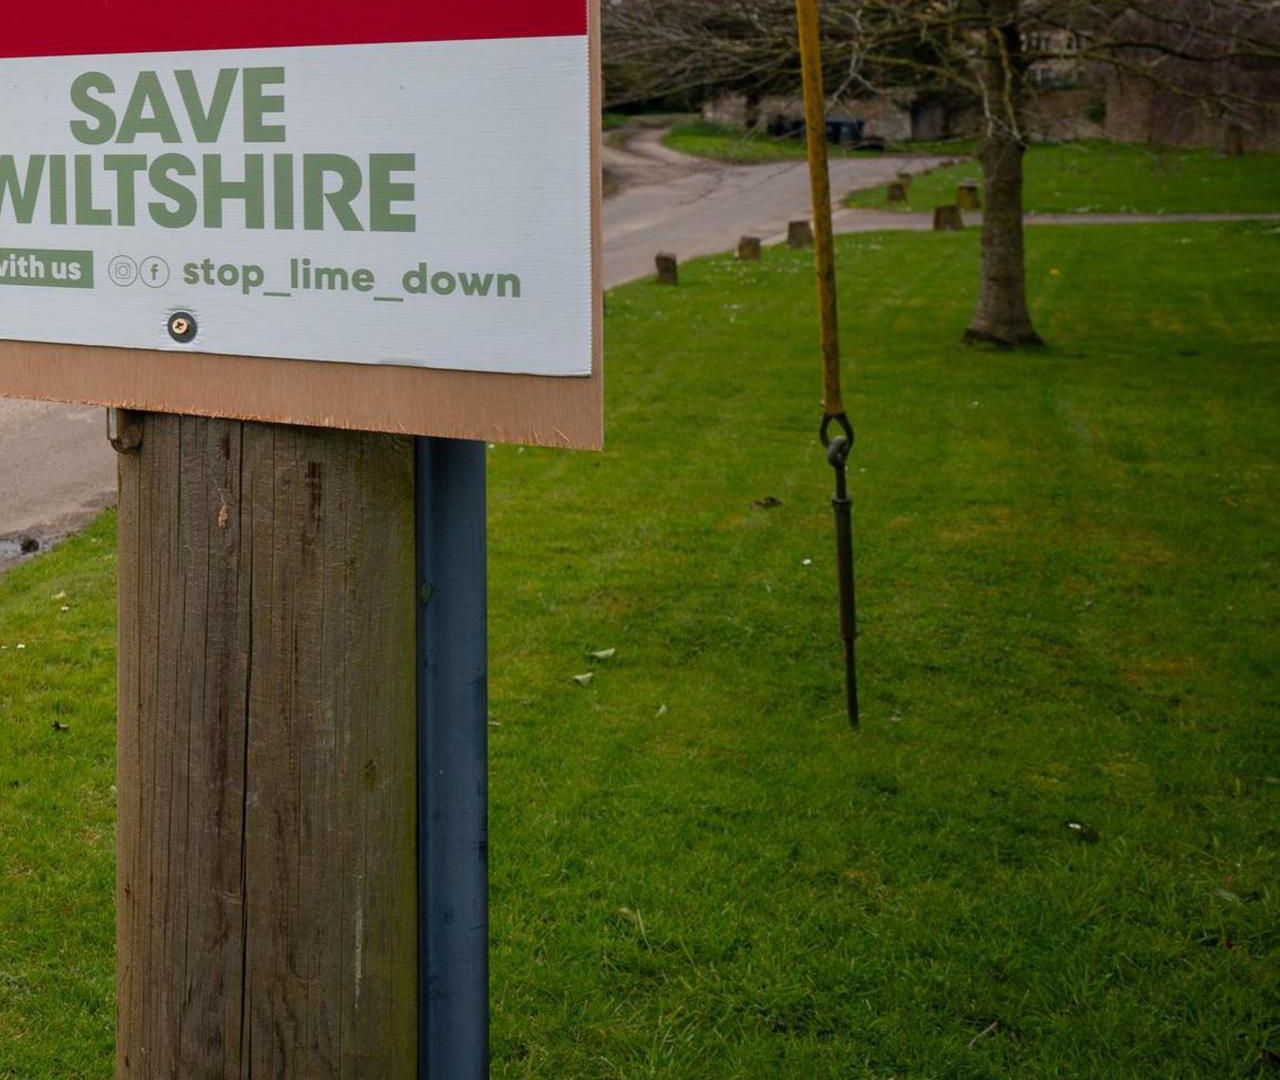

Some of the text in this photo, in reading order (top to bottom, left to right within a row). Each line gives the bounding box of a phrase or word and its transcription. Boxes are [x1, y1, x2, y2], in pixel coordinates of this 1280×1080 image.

[69, 66, 286, 146] SAVE
[51, 260, 82, 281] us
[183, 257, 521, 302] stop_lime_down
